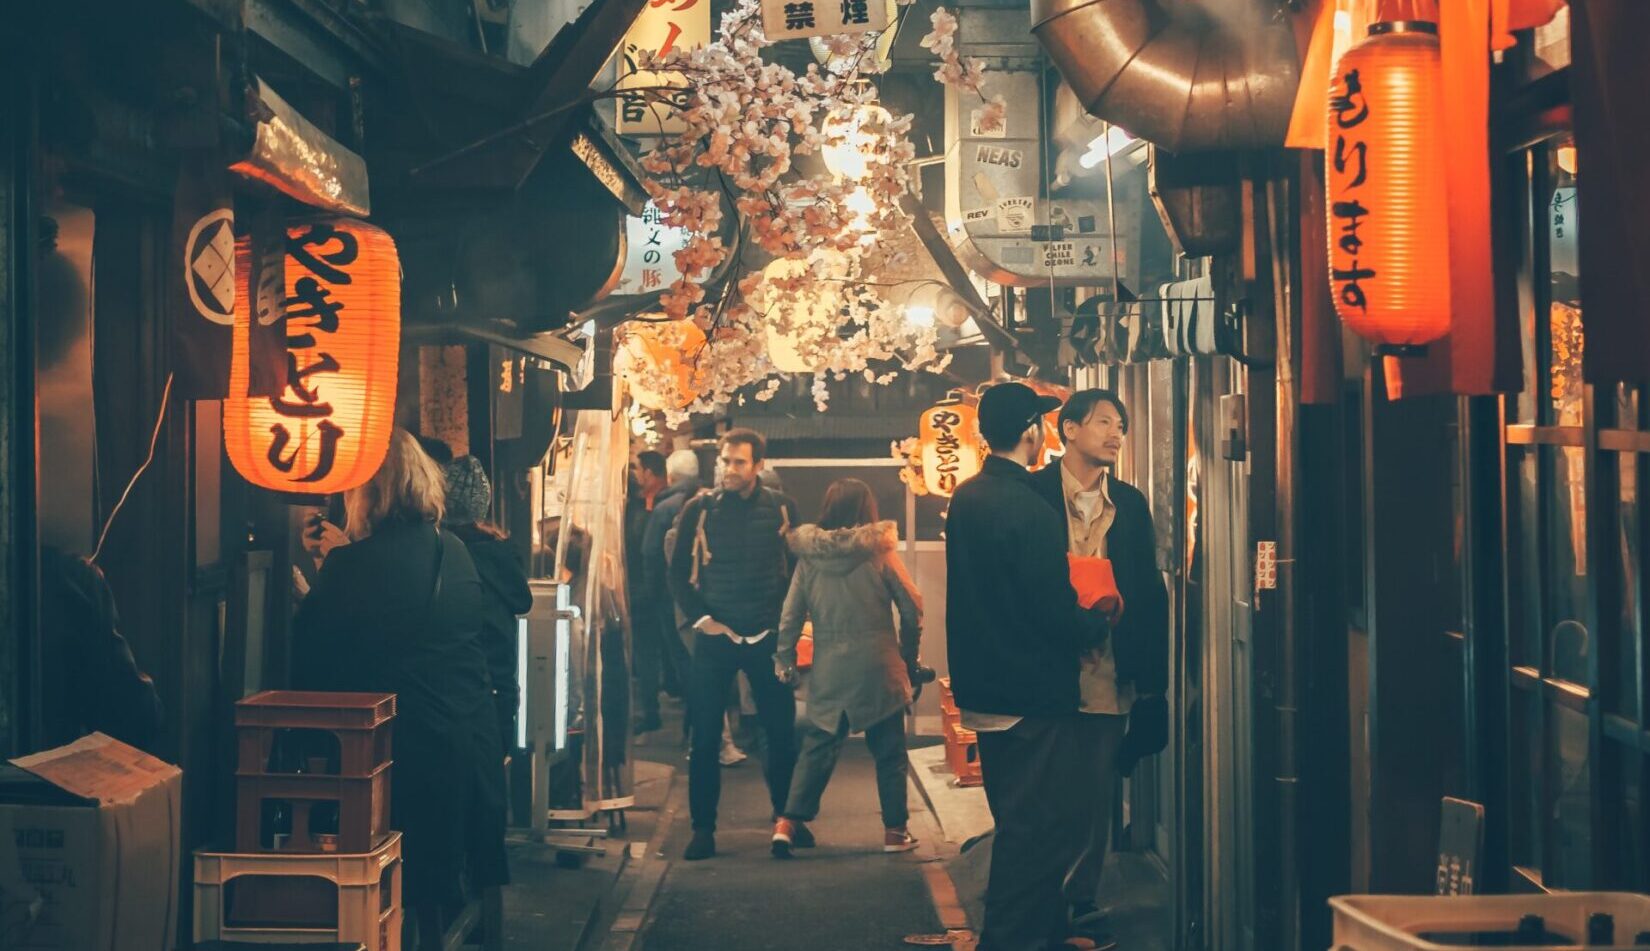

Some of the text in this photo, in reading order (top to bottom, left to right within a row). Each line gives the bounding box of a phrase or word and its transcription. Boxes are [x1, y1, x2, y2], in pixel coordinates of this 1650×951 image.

[783, 0, 869, 30] 禁煙
[967, 210, 988, 219] REV
[267, 224, 359, 482] やきとり
[932, 411, 960, 493] やきとり
